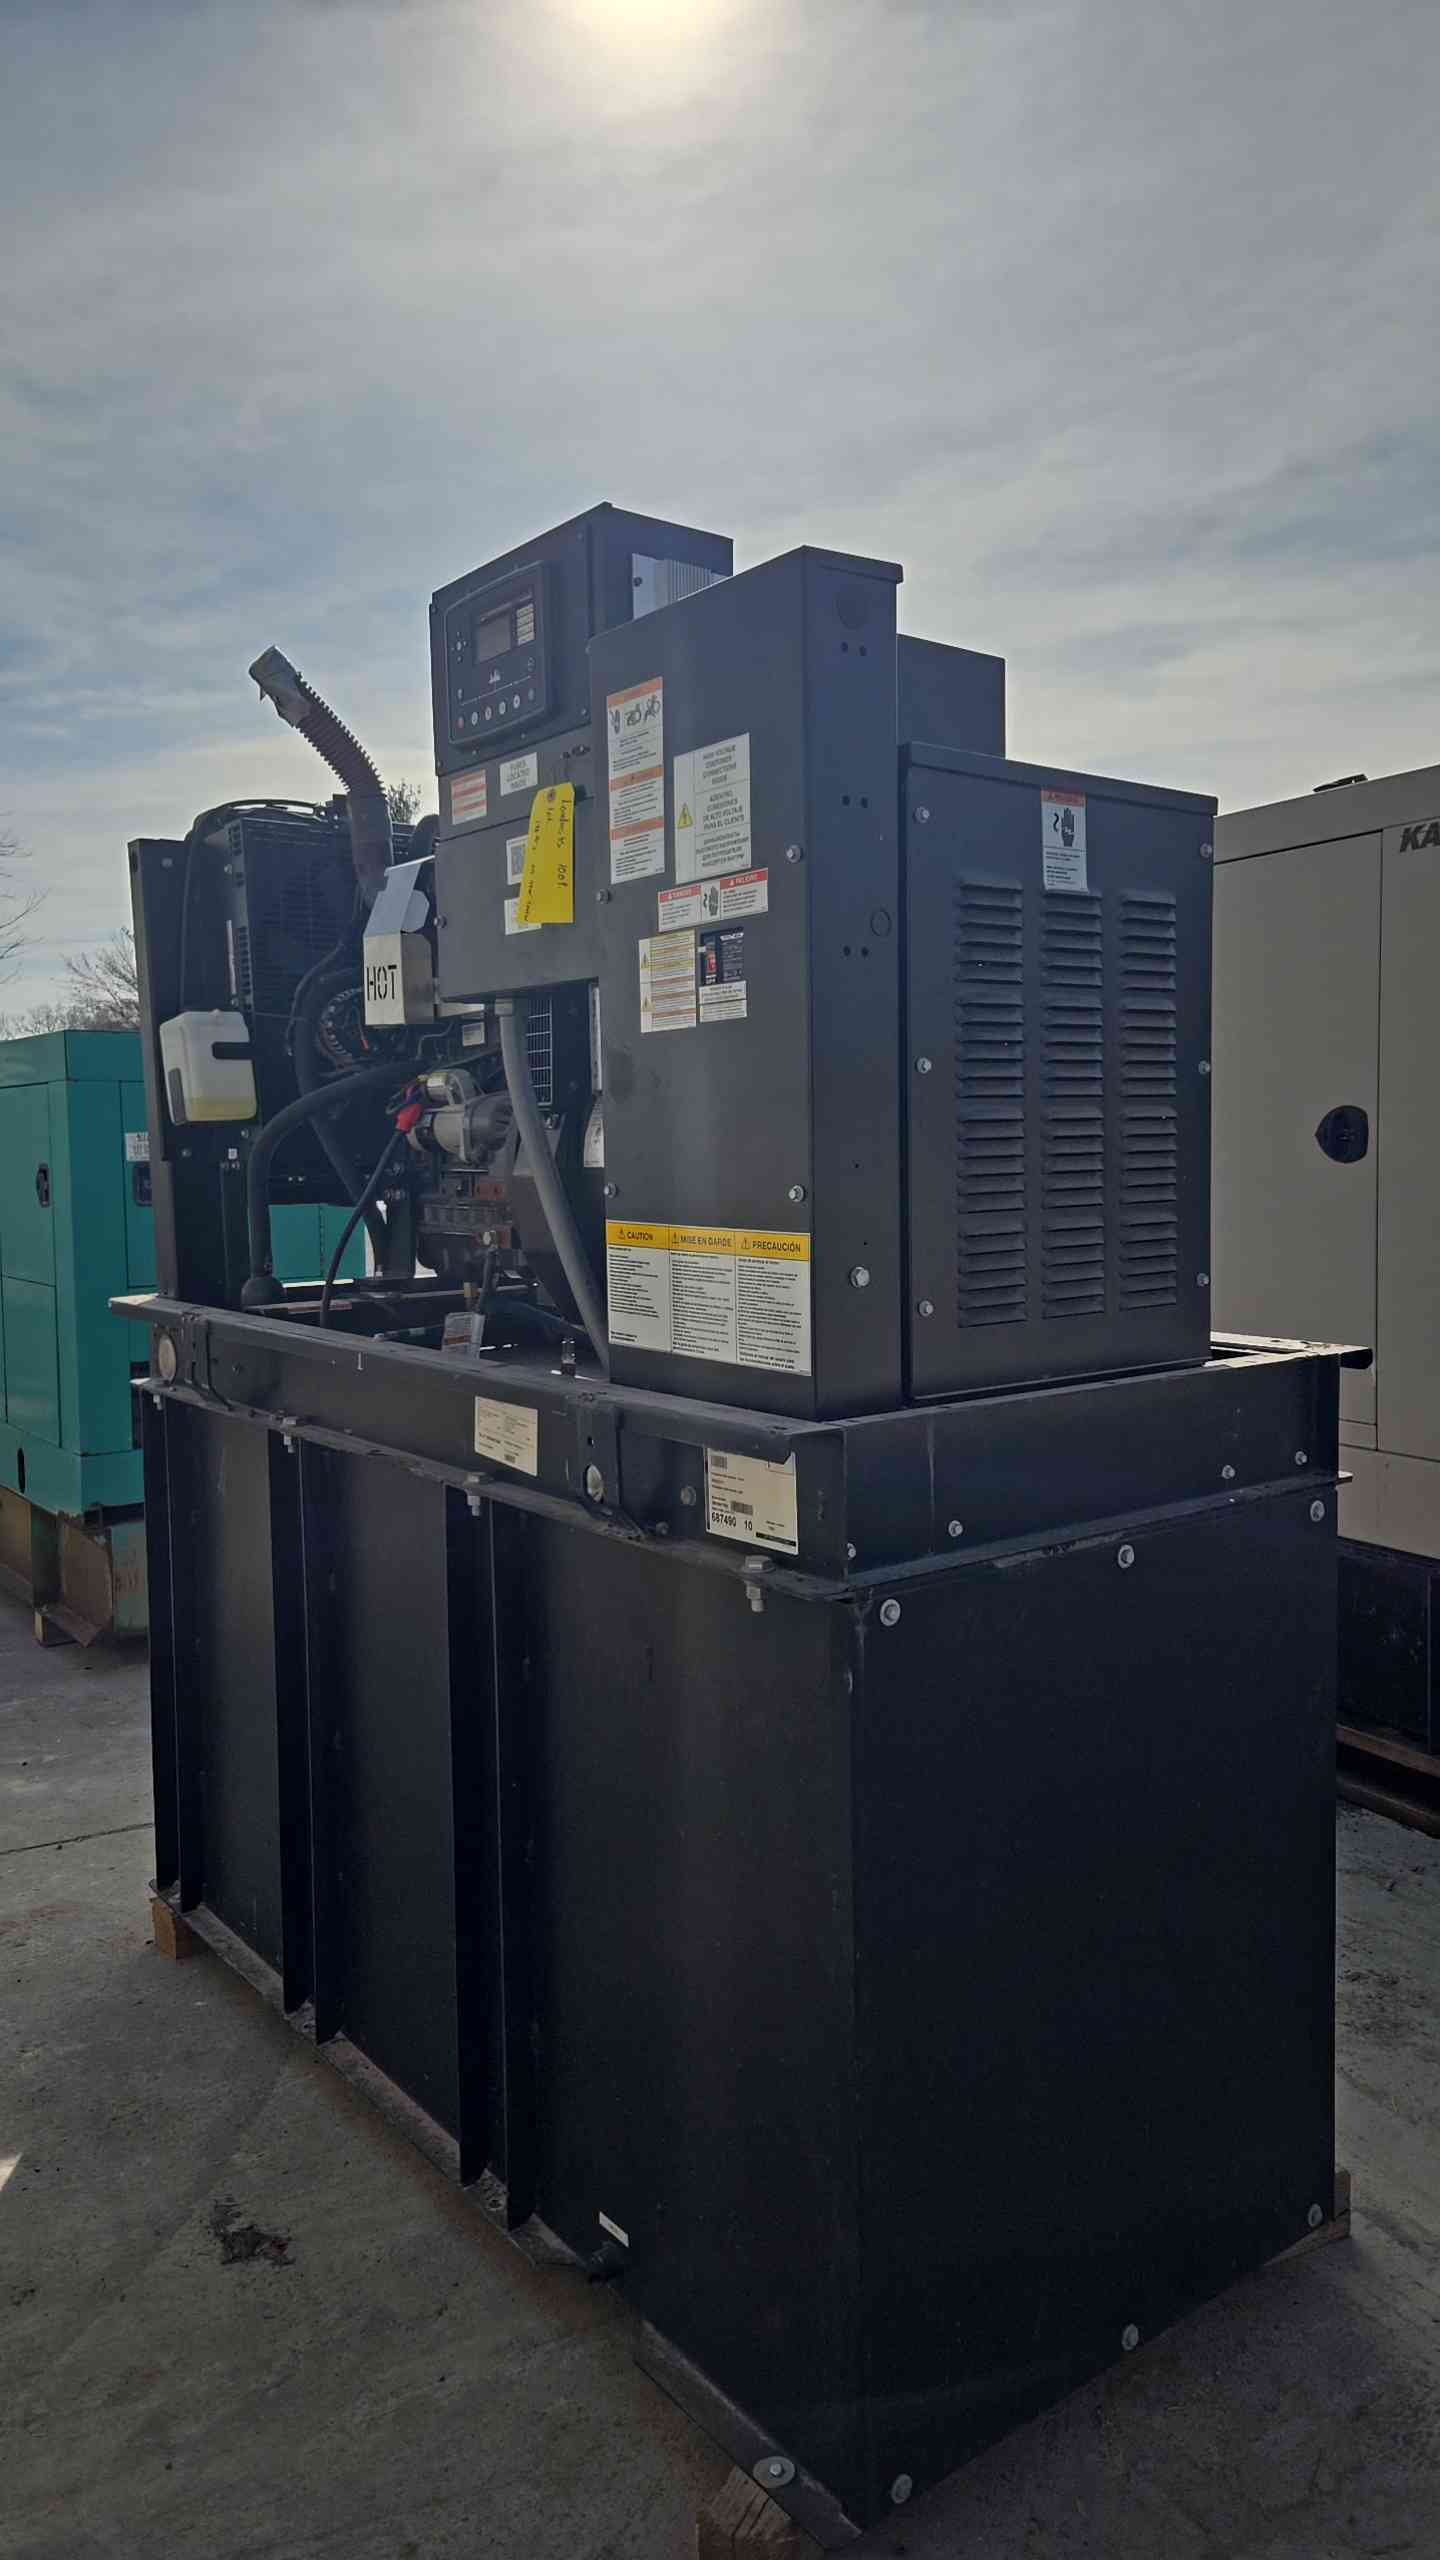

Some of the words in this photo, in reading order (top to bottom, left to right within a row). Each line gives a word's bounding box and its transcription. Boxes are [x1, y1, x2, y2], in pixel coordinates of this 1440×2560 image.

[367, 965, 397, 1000] HOT
[627, 1231, 653, 1241] CAUTION
[697, 1236, 708, 1246] EN
[752, 1240, 801, 1252] PRECAUCIÓN
[744, 1519, 753, 1531] 10
